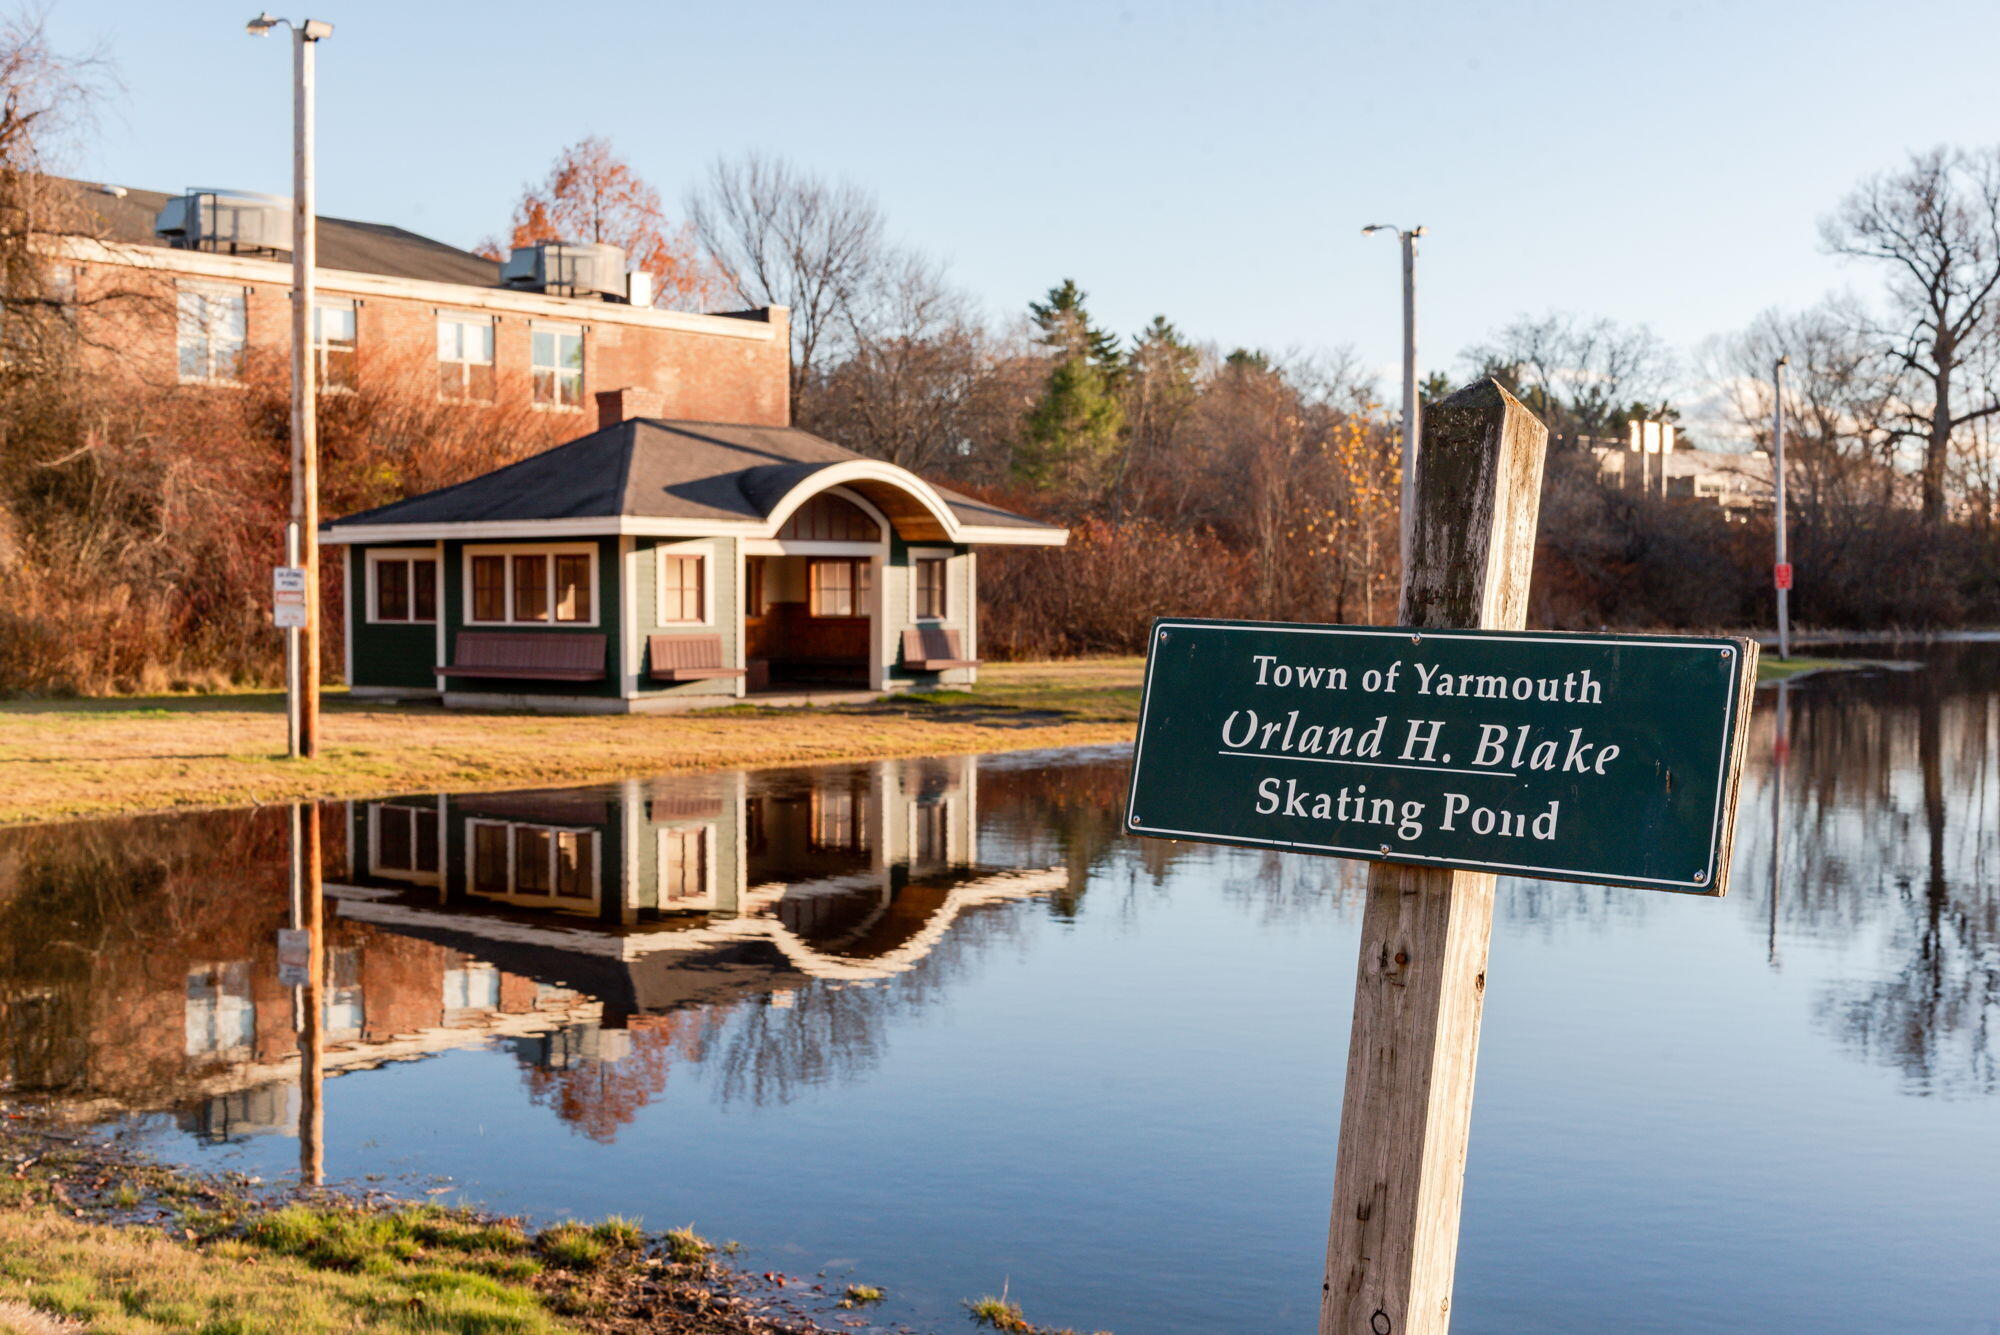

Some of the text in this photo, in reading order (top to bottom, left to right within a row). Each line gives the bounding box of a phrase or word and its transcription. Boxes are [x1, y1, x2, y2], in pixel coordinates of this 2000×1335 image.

[1252, 655, 1602, 704] Town of Yarmouth
[1222, 709, 1620, 776] Orland H. Blake
[1255, 777, 1560, 841] Skating Pond
